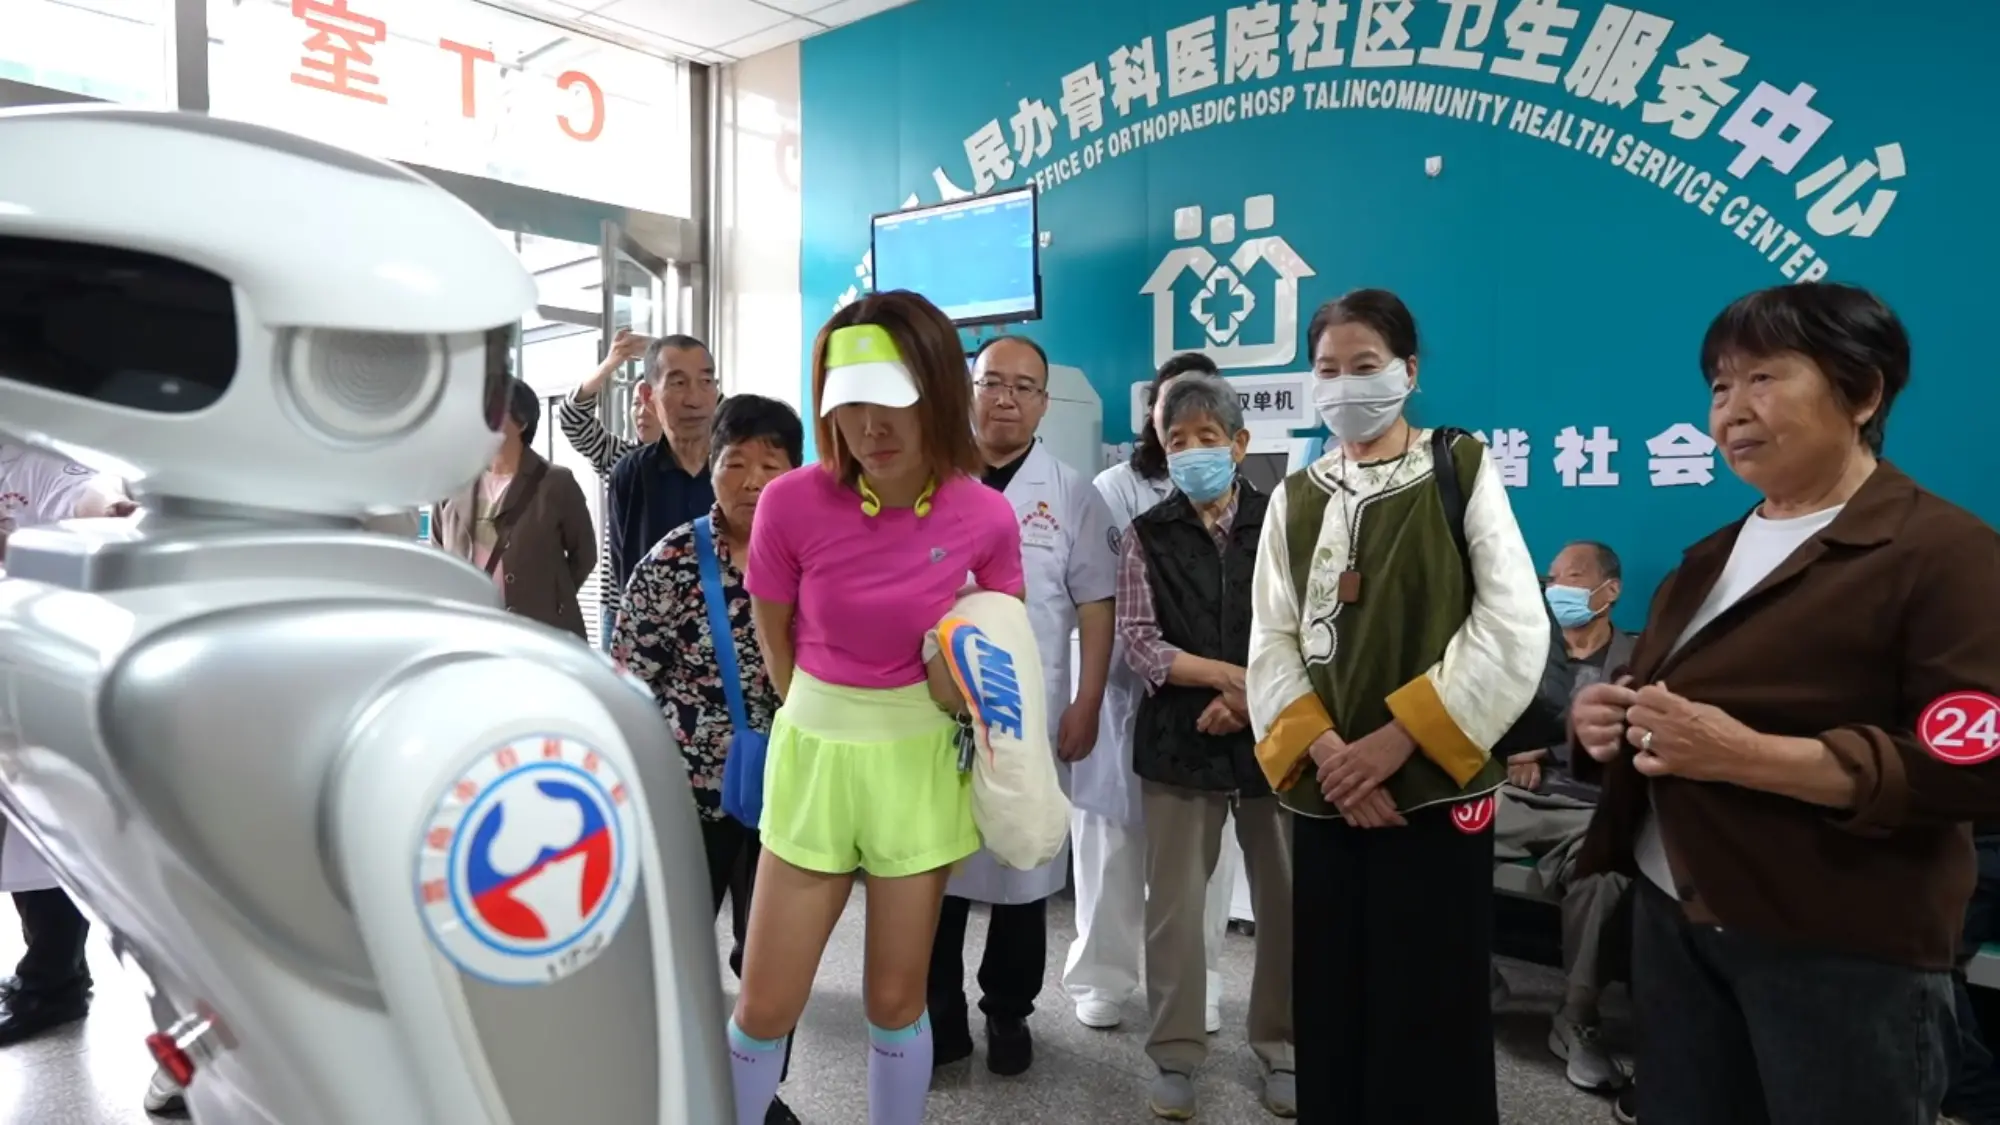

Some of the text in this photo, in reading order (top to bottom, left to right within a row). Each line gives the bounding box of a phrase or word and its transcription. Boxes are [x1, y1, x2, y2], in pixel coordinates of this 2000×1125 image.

[1083, 138, 1104, 169] OF
[1108, 97, 1236, 157] ORTHOPAEDIC
[1240, 85, 1295, 119] HOSP
[1509, 100, 1615, 158] HEALTH
[1611, 134, 1729, 215] SERVICE
[974, 637, 1023, 741] NIKE
[1932, 707, 1999, 748] 24
